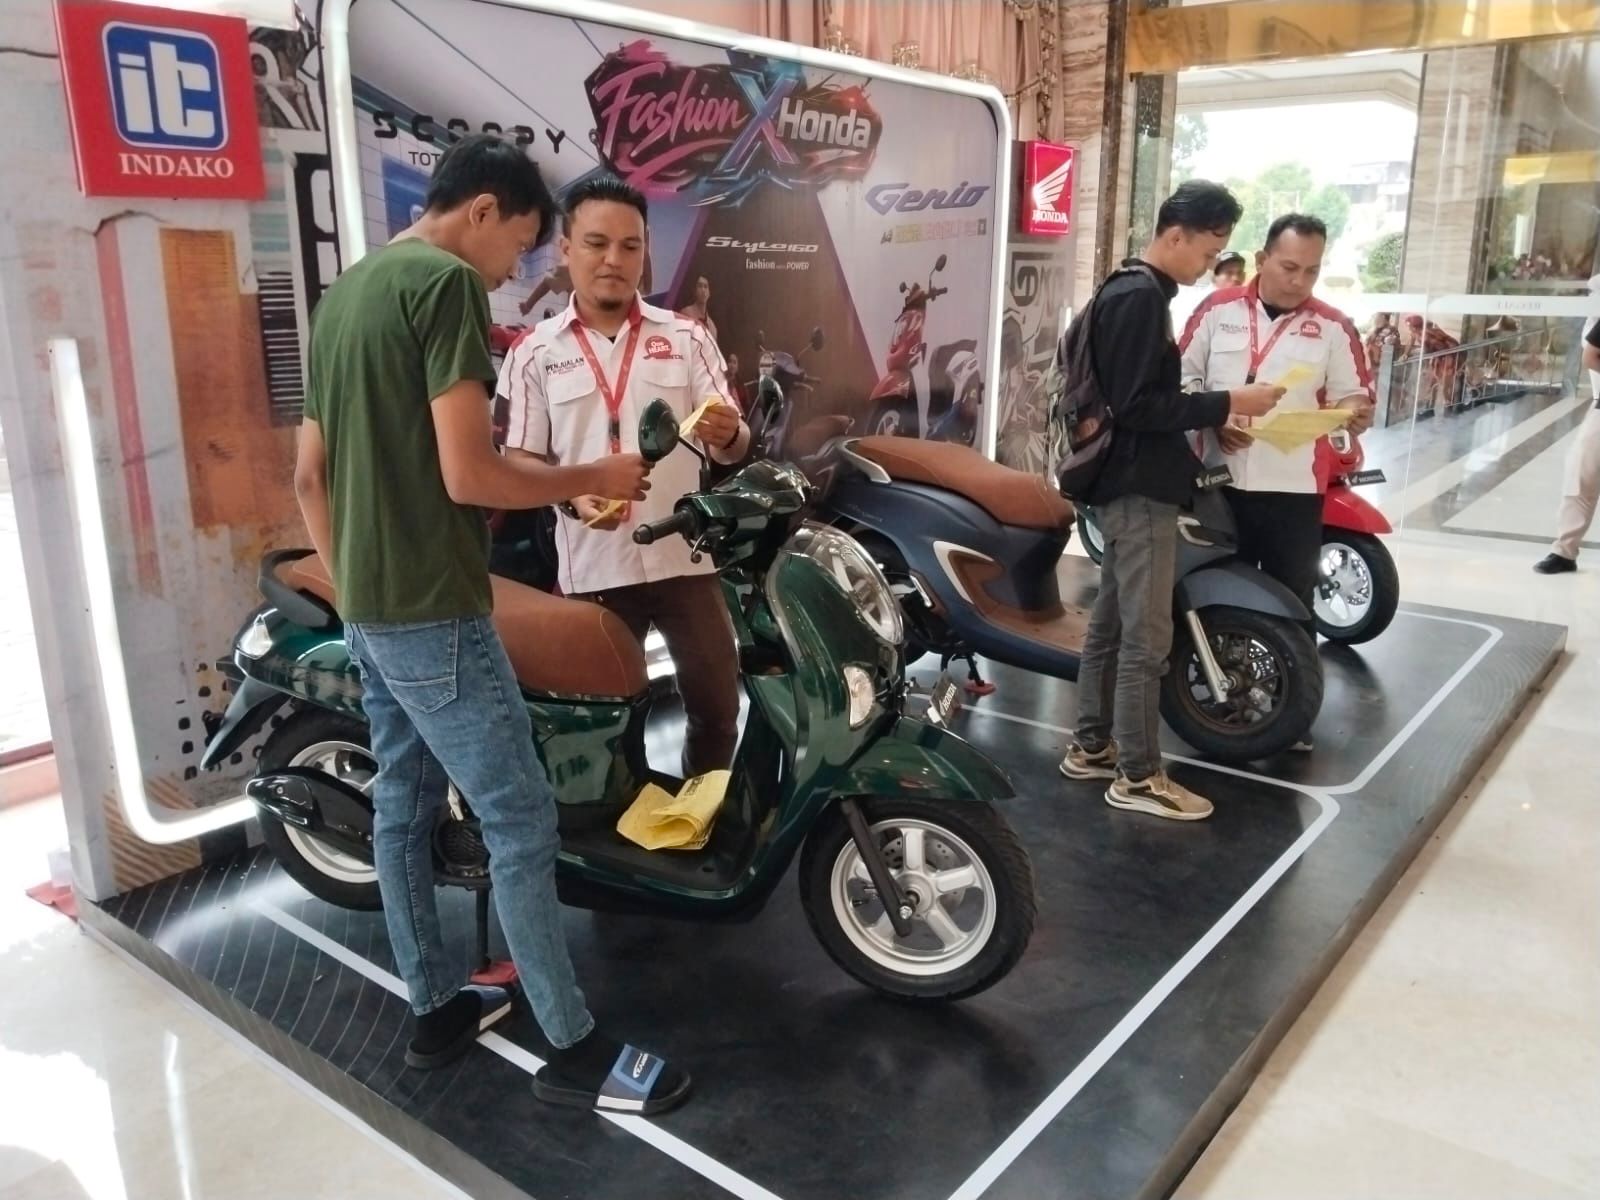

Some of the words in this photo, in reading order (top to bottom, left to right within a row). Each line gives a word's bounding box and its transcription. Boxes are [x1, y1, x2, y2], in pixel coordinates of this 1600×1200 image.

[596, 62, 749, 160] Fashion
[711, 70, 800, 179] X
[776, 97, 872, 149] Honda
[118, 152, 235, 178] INDAKO
[865, 181, 990, 216] Genio
[1032, 209, 1069, 224] HONDA
[745, 258, 776, 269] fashion
[786, 261, 810, 271] POWER
[545, 356, 585, 372] PENJUALAN
[942, 682, 958, 711] HONDA
